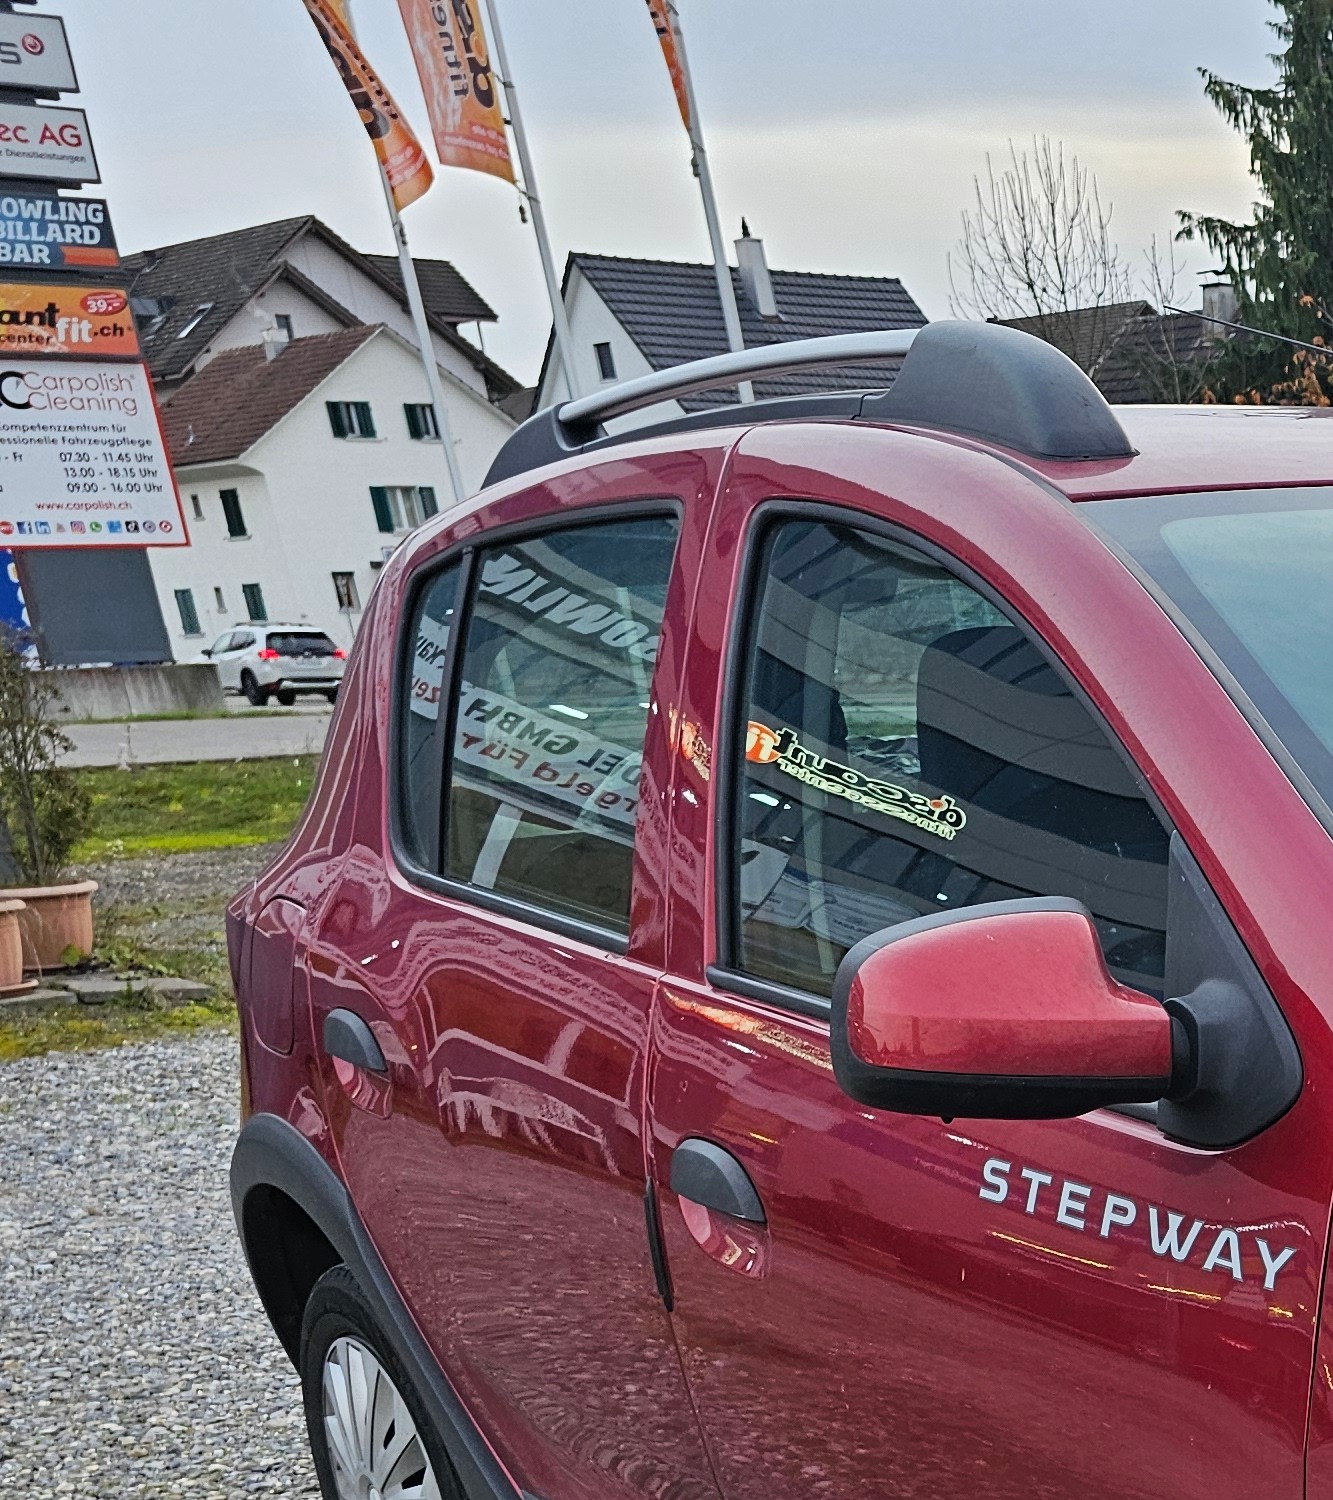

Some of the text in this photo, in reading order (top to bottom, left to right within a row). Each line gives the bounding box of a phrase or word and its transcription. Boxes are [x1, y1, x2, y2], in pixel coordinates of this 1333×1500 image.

[39, 122, 83, 148] AG
[0, 197, 104, 224] OWLING
[23, 371, 134, 395] Carpolish
[28, 391, 138, 416] Cleaning
[0, 422, 127, 433] ompetenzzentrum für
[61, 436, 153, 448] Fahrzeugpflege
[59, 452, 91, 463] 07.30
[135, 452, 154, 463] Uhr
[139, 467, 158, 478] Uhr
[67, 482, 99, 493] 09.00
[144, 482, 163, 493] Uhr
[34, 500, 133, 512] www.carpolish.ch
[978, 1157, 1297, 1292] STEPWAY
